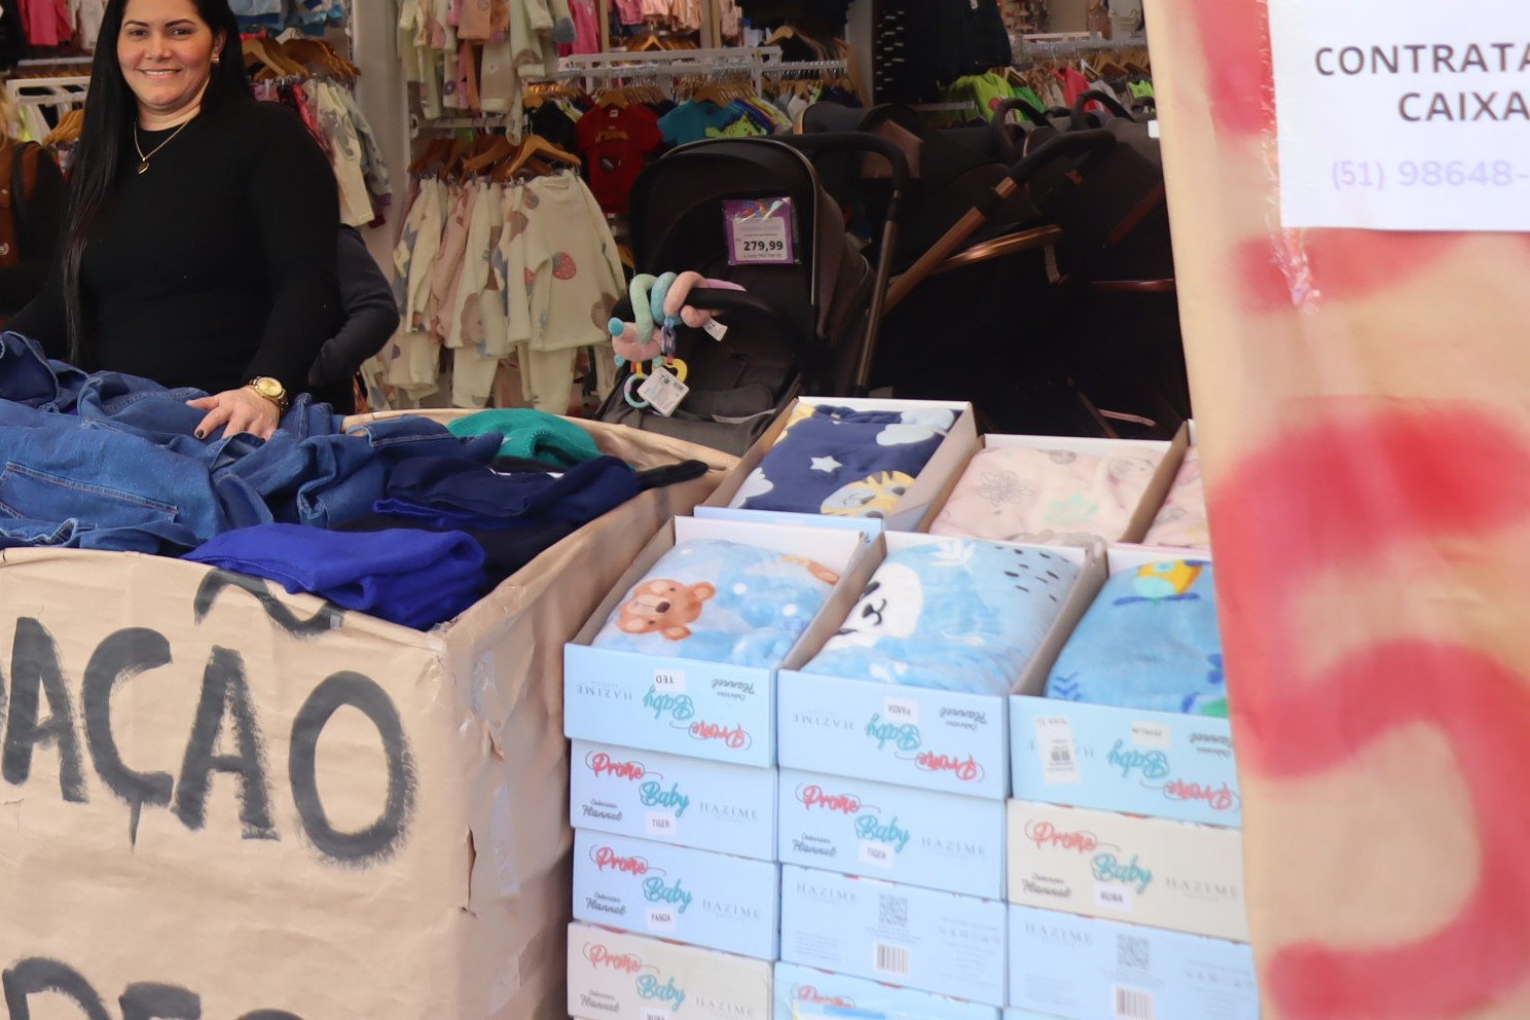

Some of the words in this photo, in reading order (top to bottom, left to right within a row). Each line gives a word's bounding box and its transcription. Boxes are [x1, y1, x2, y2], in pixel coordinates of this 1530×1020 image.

[1398, 91, 1530, 122] CAIXA
[1331, 161, 1384, 192] (51)
[743, 240, 783, 252] 279,99
[639, 781, 690, 817] Baby
[642, 876, 693, 913] Baby
